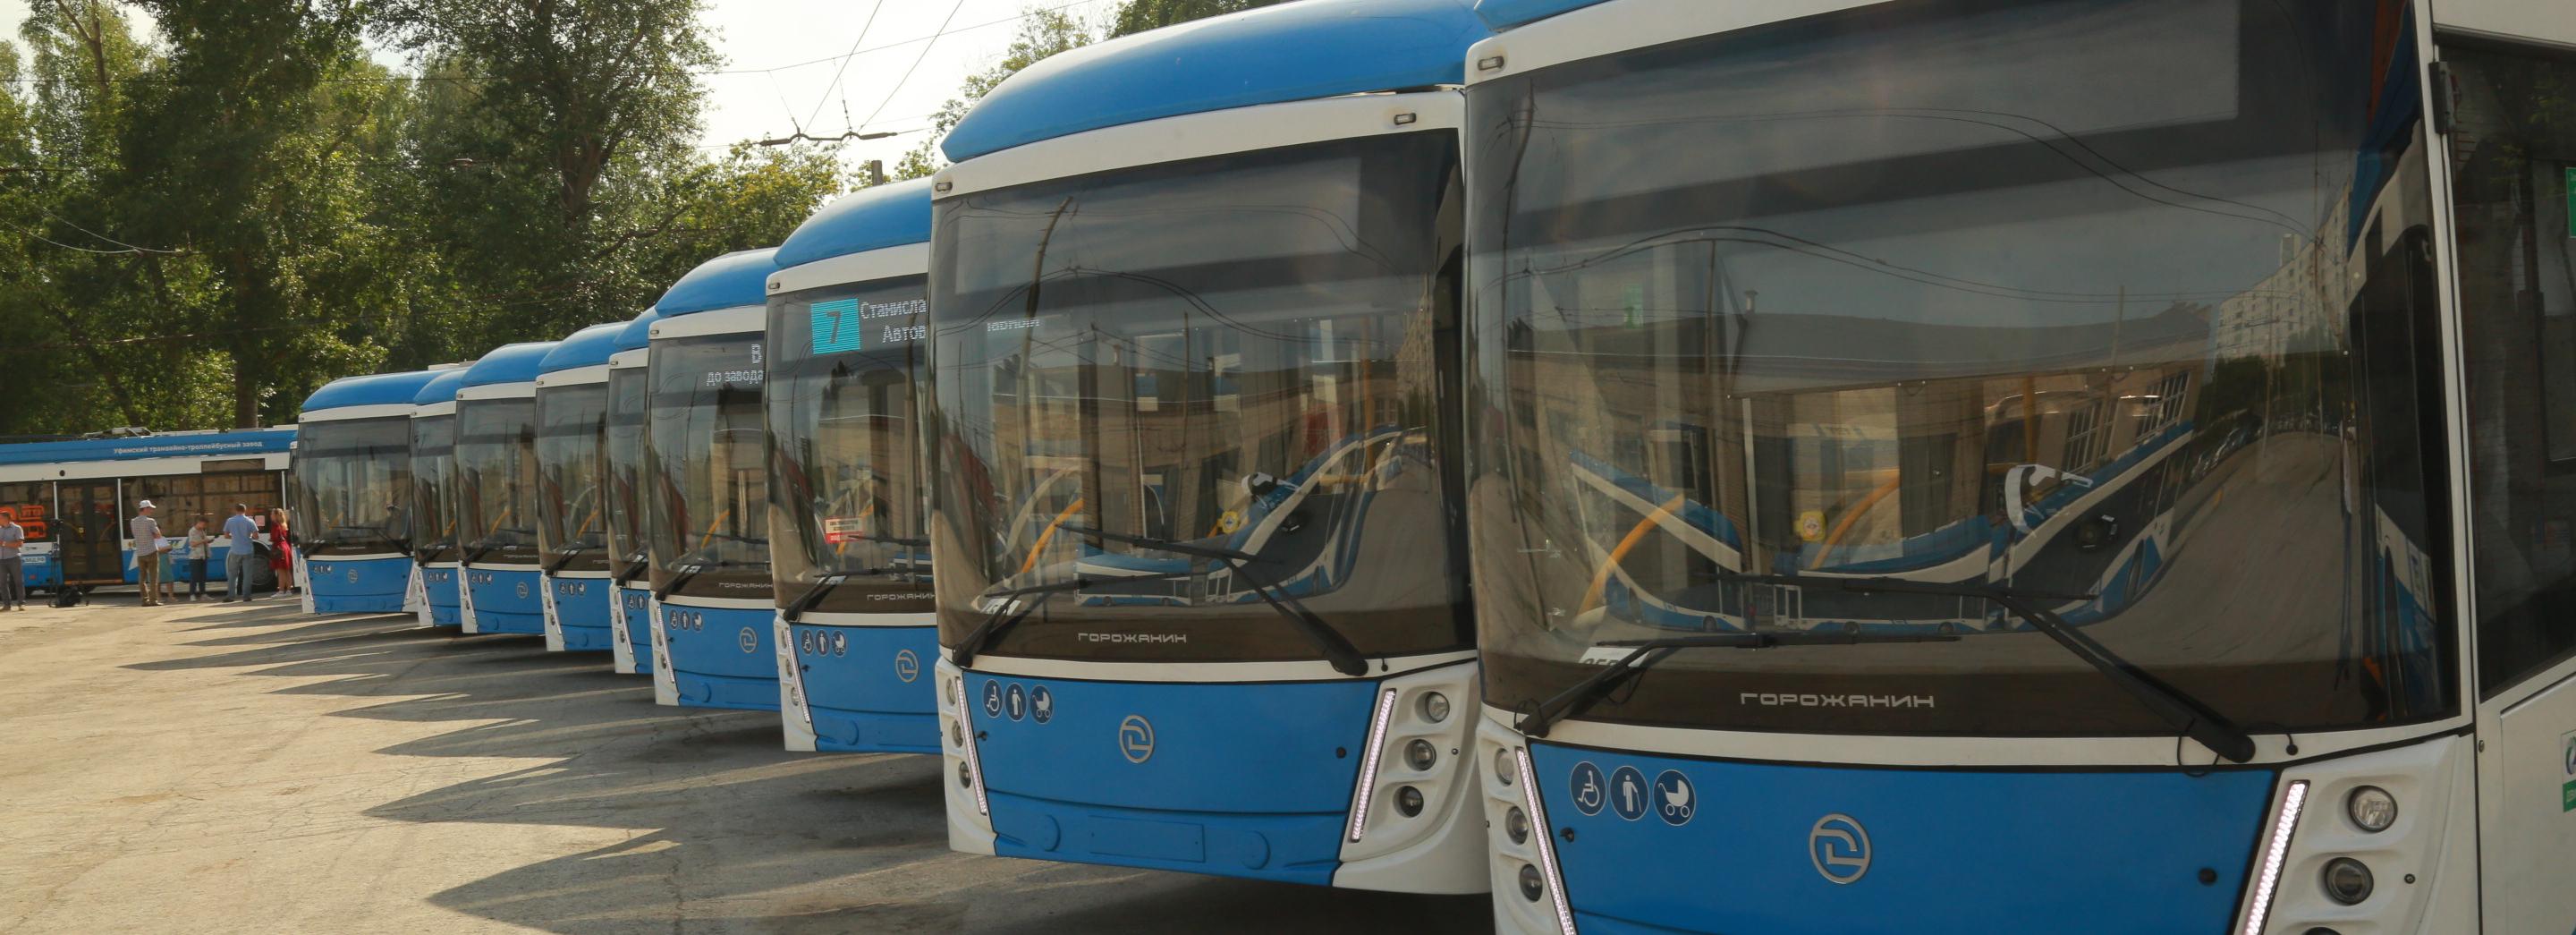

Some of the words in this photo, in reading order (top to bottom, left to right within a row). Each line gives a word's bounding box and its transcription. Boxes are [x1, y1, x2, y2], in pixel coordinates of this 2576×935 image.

[826, 310, 841, 344] 7
[706, 371, 722, 386] до
[1078, 633, 1187, 643] ГОРОЖАНИН
[1741, 693, 1934, 708] ГОРОЖАНИН
